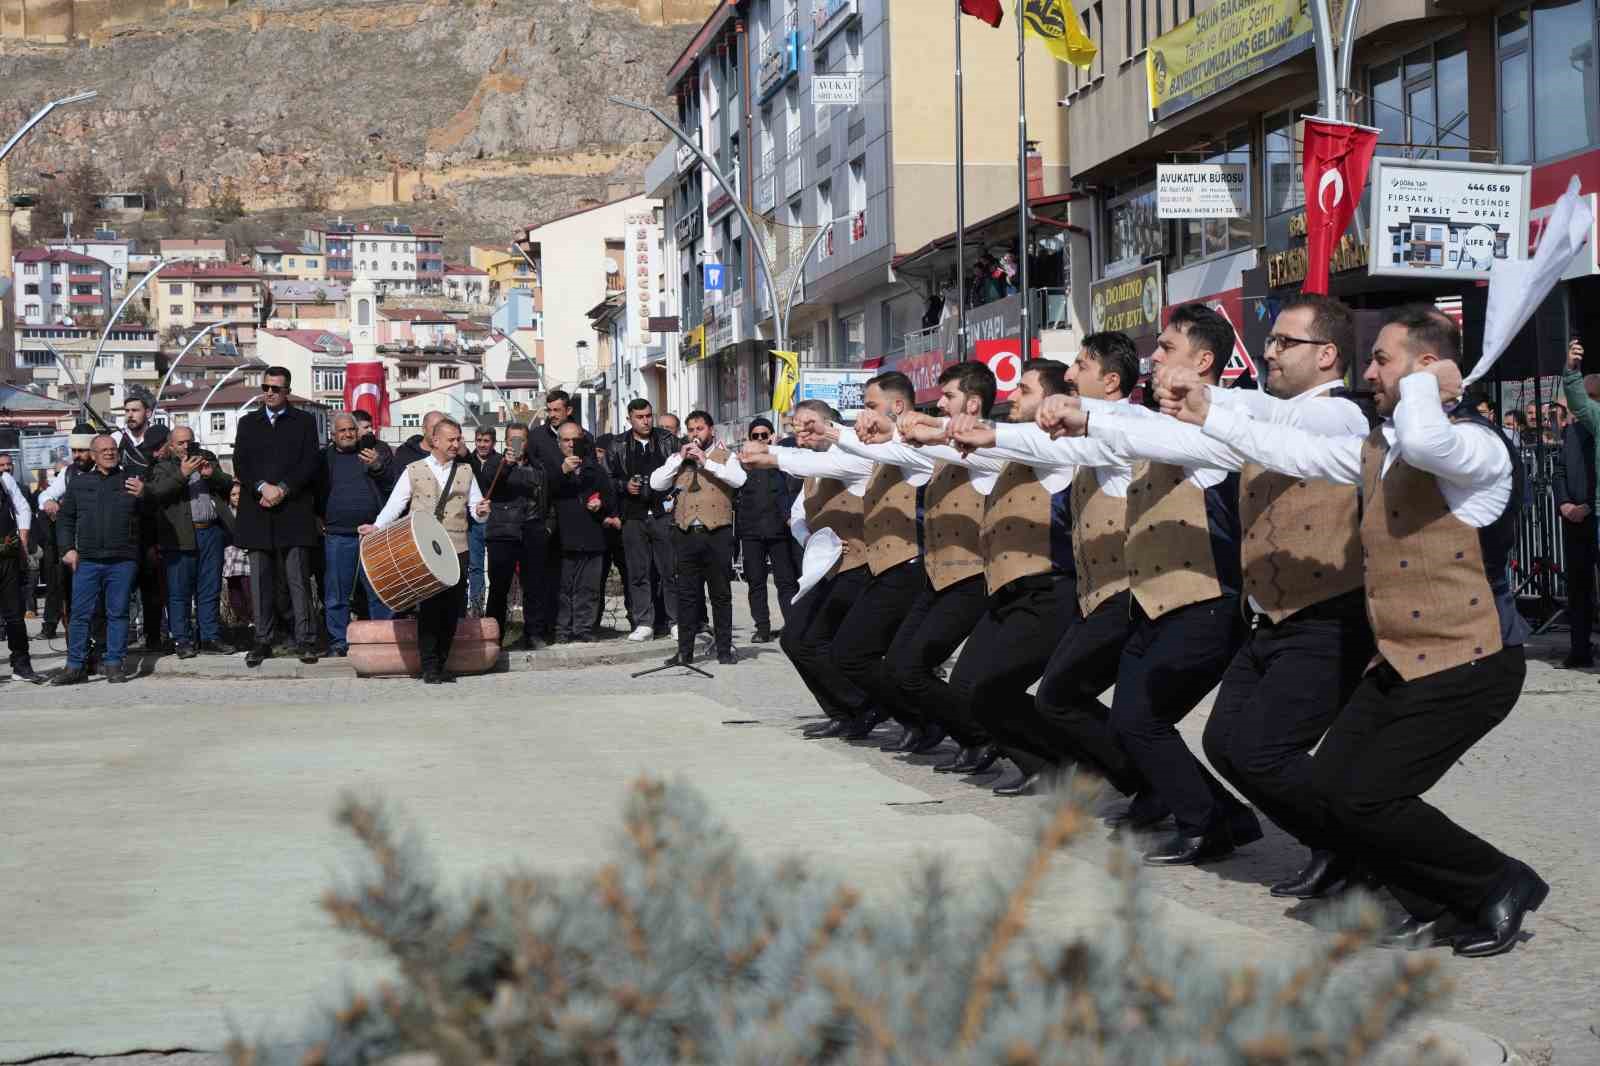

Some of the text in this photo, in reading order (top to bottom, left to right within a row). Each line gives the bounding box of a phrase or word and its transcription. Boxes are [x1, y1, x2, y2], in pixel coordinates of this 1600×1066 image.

[1160, 173, 1207, 183] AVUKATLIK
[1467, 183, 1511, 193] 444 65 69
[1465, 238, 1485, 247] LIFE
